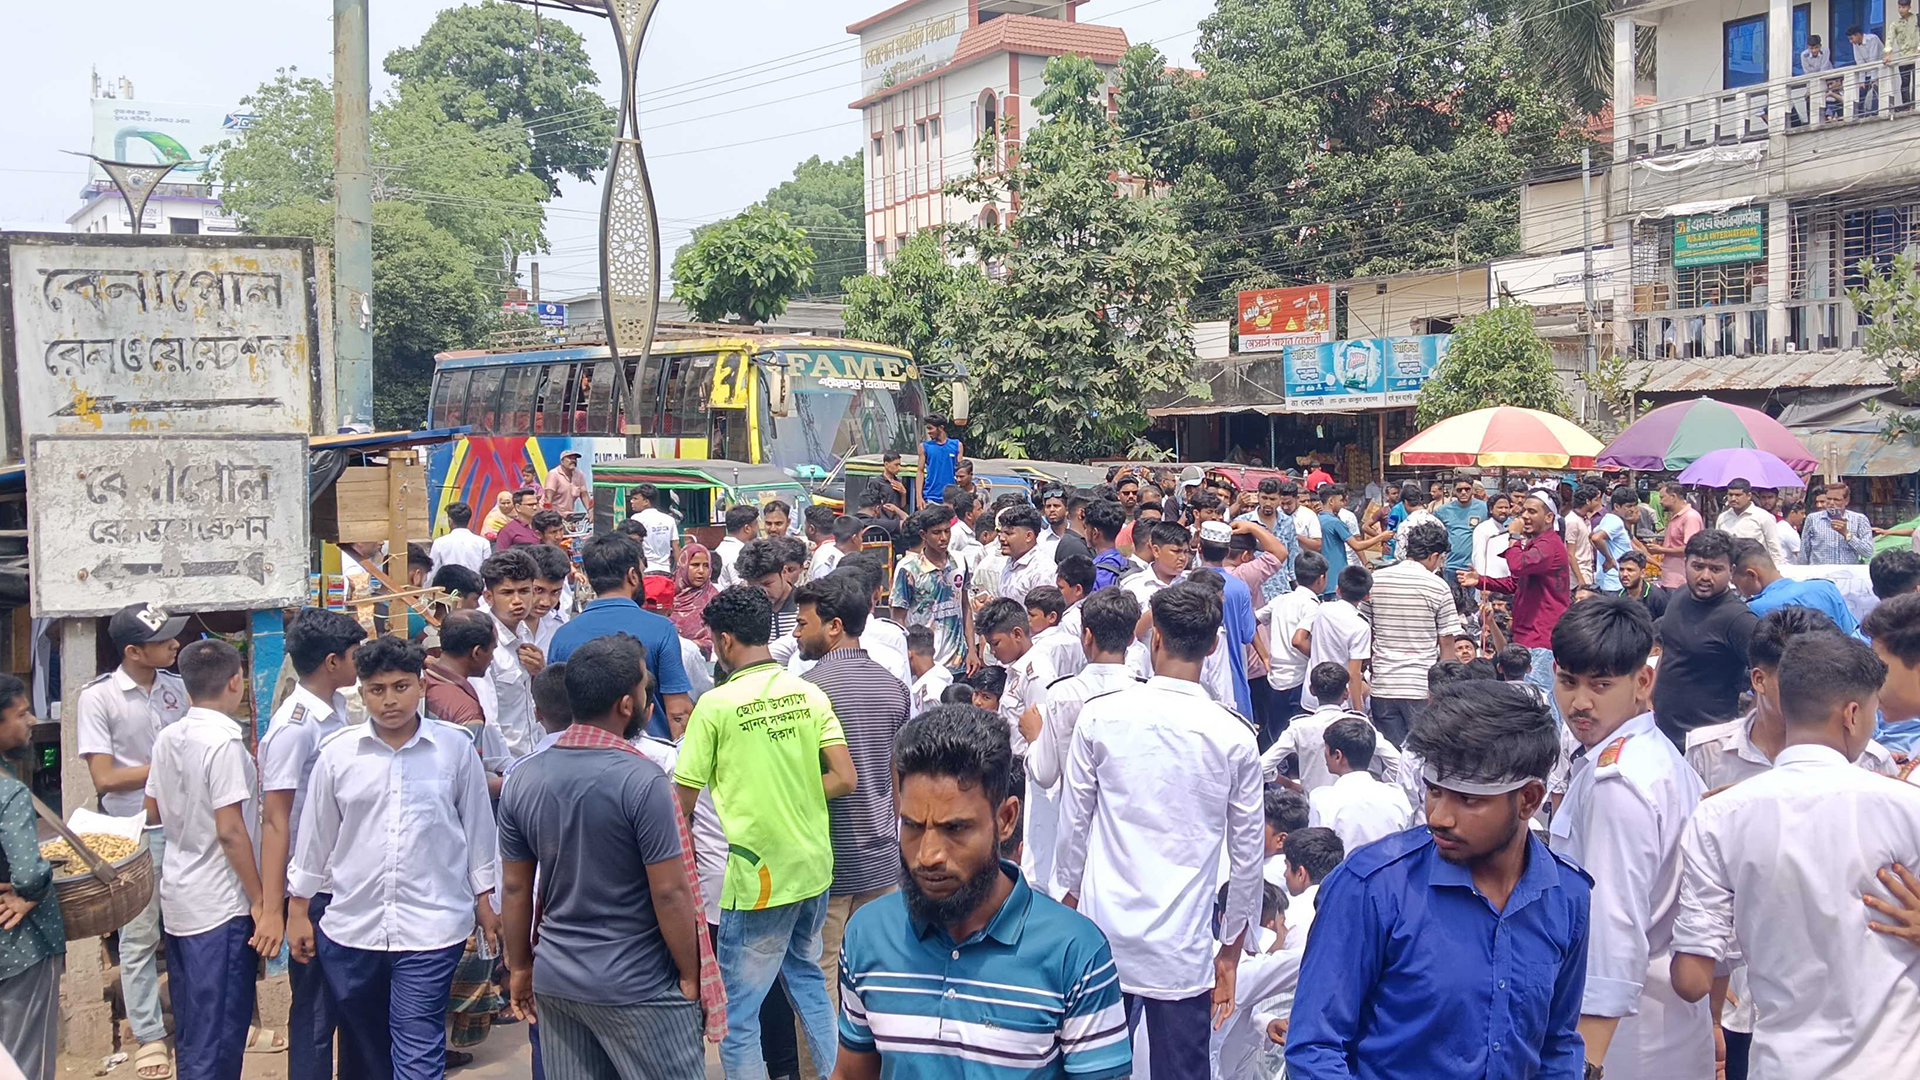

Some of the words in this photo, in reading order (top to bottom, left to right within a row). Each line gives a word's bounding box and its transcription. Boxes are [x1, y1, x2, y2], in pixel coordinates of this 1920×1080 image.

[33, 268, 283, 314] বেনাপোল
[787, 353, 907, 382] FAME
[738, 716, 769, 733] মানব
[766, 726, 797, 743] বিকাশ
